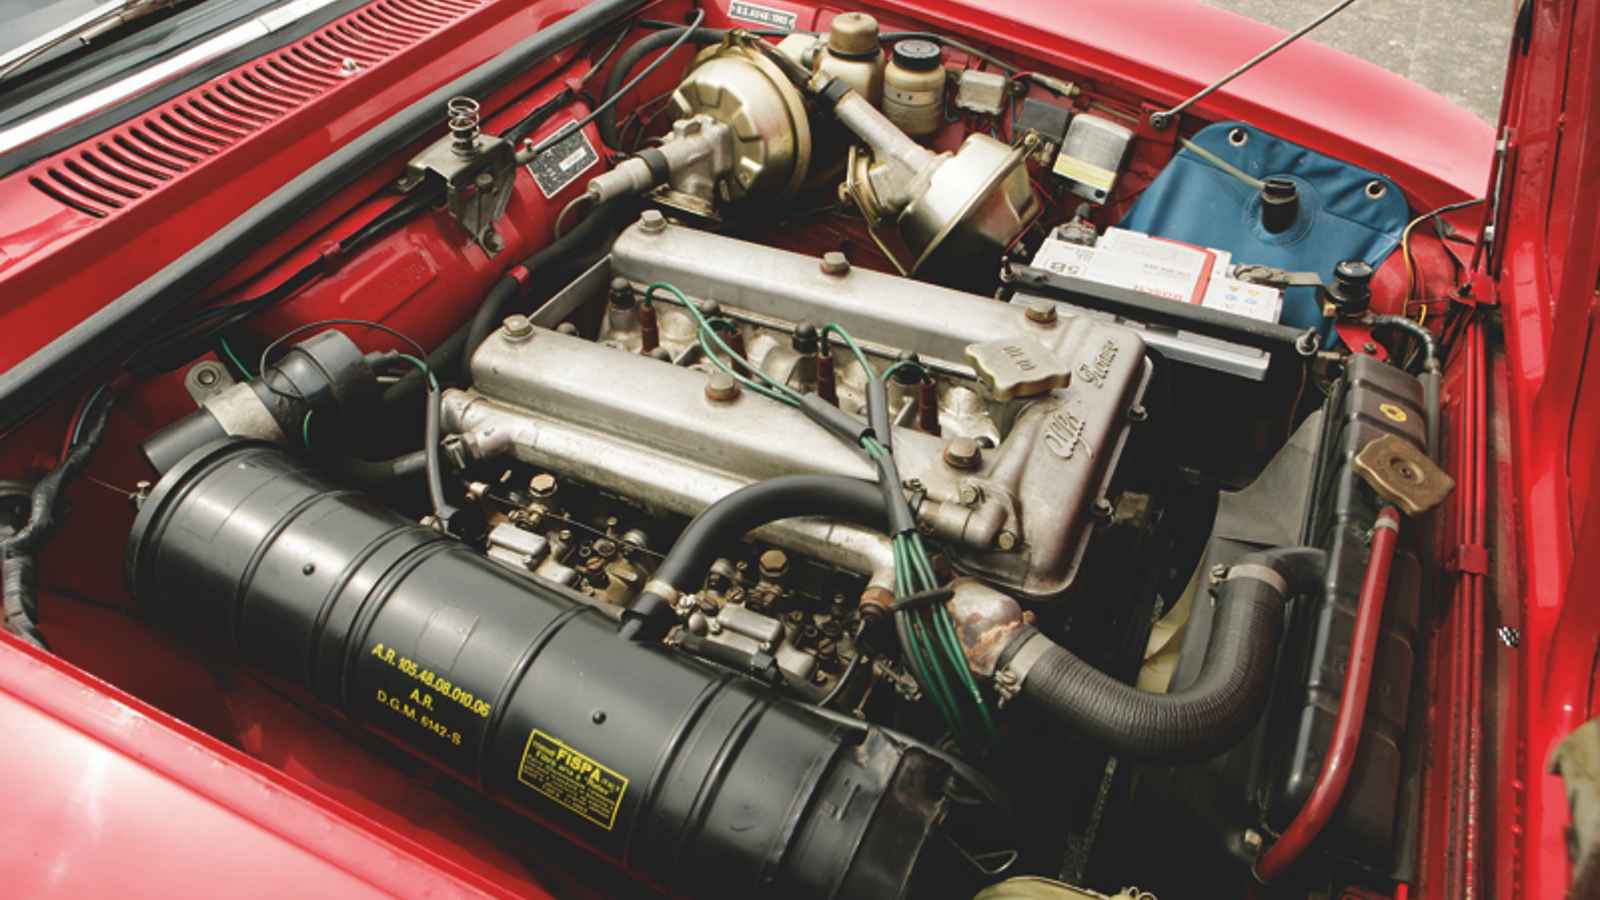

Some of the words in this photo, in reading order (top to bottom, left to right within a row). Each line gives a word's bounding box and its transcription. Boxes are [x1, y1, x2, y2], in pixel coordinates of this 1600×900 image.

[371, 642, 396, 666] A.R.
[398, 657, 492, 718] 105.48.08.010.06
[377, 689, 418, 722] D.G.M.
[409, 688, 434, 711] A.R.
[556, 748, 602, 782] FISPA
